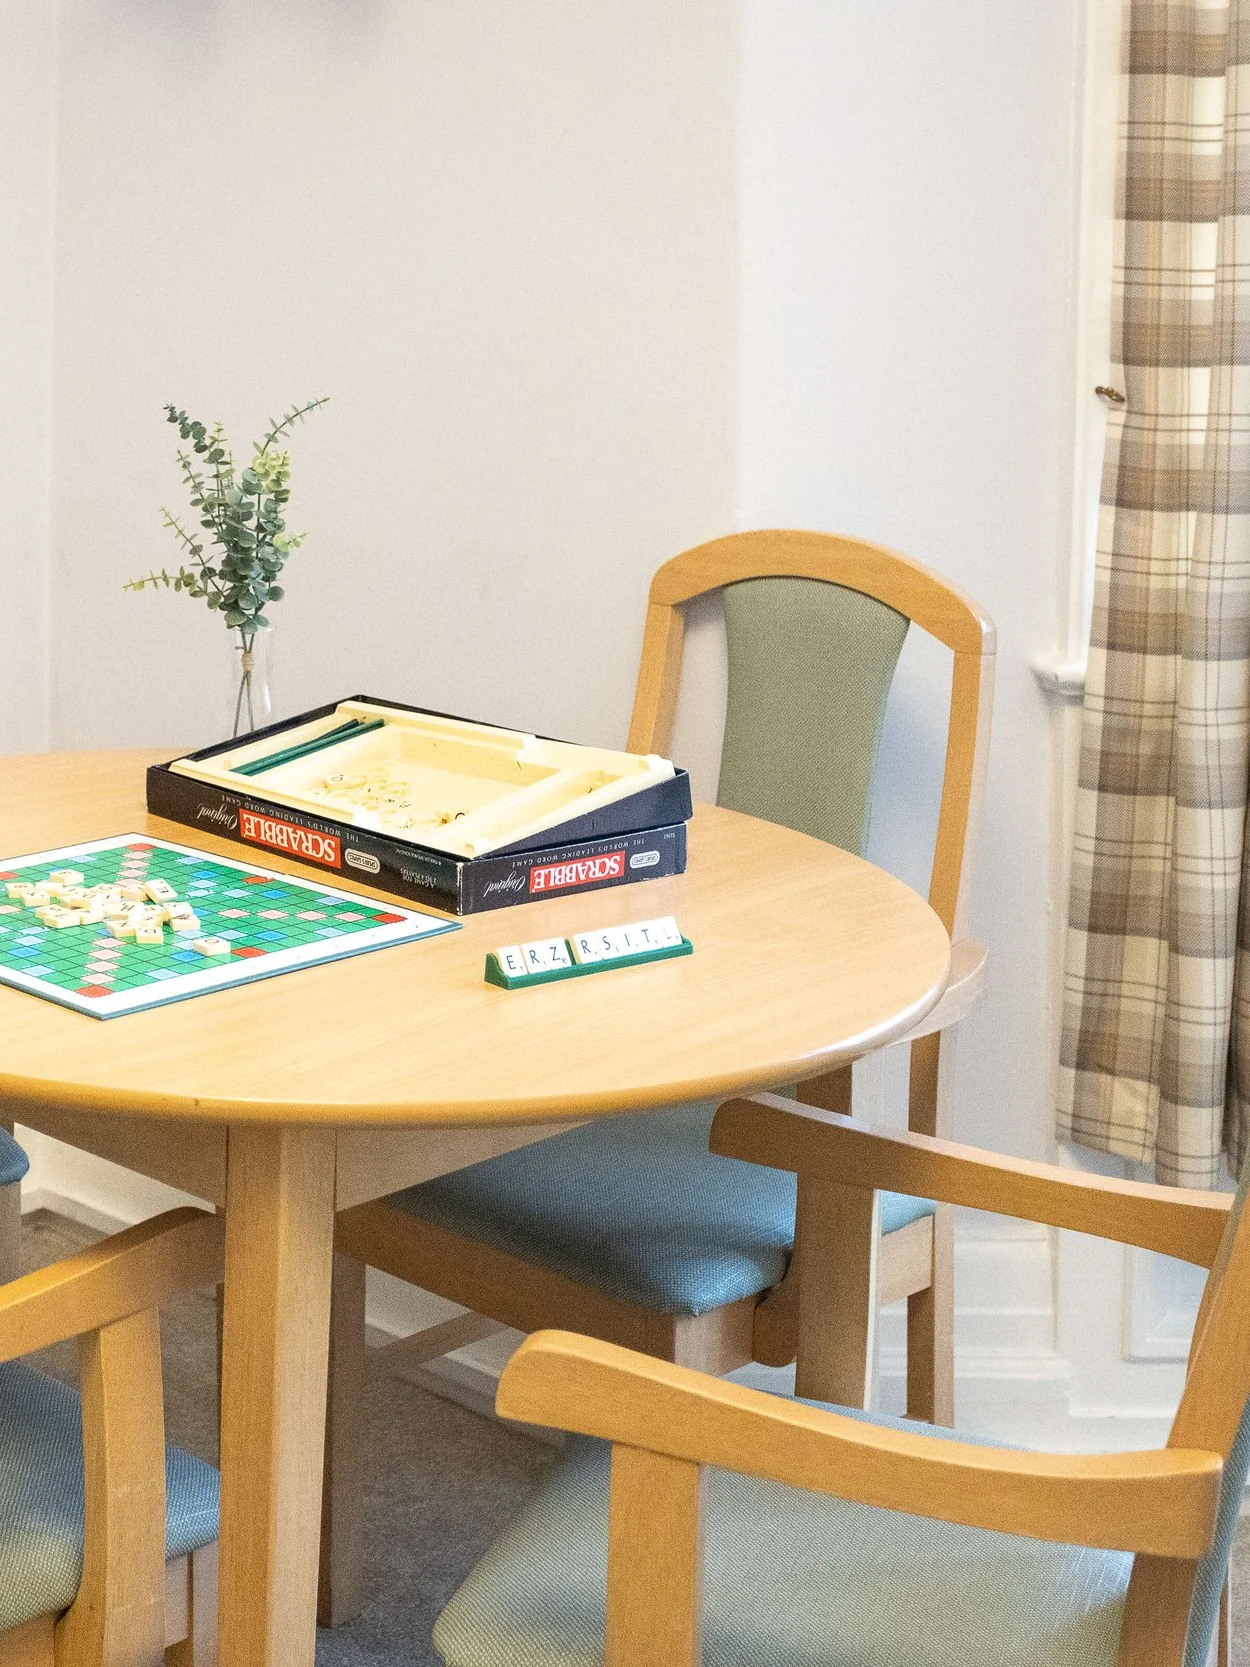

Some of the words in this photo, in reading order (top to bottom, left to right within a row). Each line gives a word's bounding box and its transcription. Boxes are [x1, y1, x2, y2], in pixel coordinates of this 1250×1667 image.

[220, 793, 242, 807] GAME
[244, 801, 267, 815] WORD
[196, 803, 239, 830] Original
[269, 807, 304, 827] LEADING
[306, 820, 341, 837] WORLD'S
[242, 812, 336, 863] SCRABBLE
[345, 832, 359, 843] THE
[633, 838, 645, 846] THE
[536, 853, 558, 864] WORD
[561, 848, 594, 860] LEADING
[511, 858, 533, 868] GAME
[533, 855, 621, 890] SCRABBLE
[483, 871, 526, 897] Original
